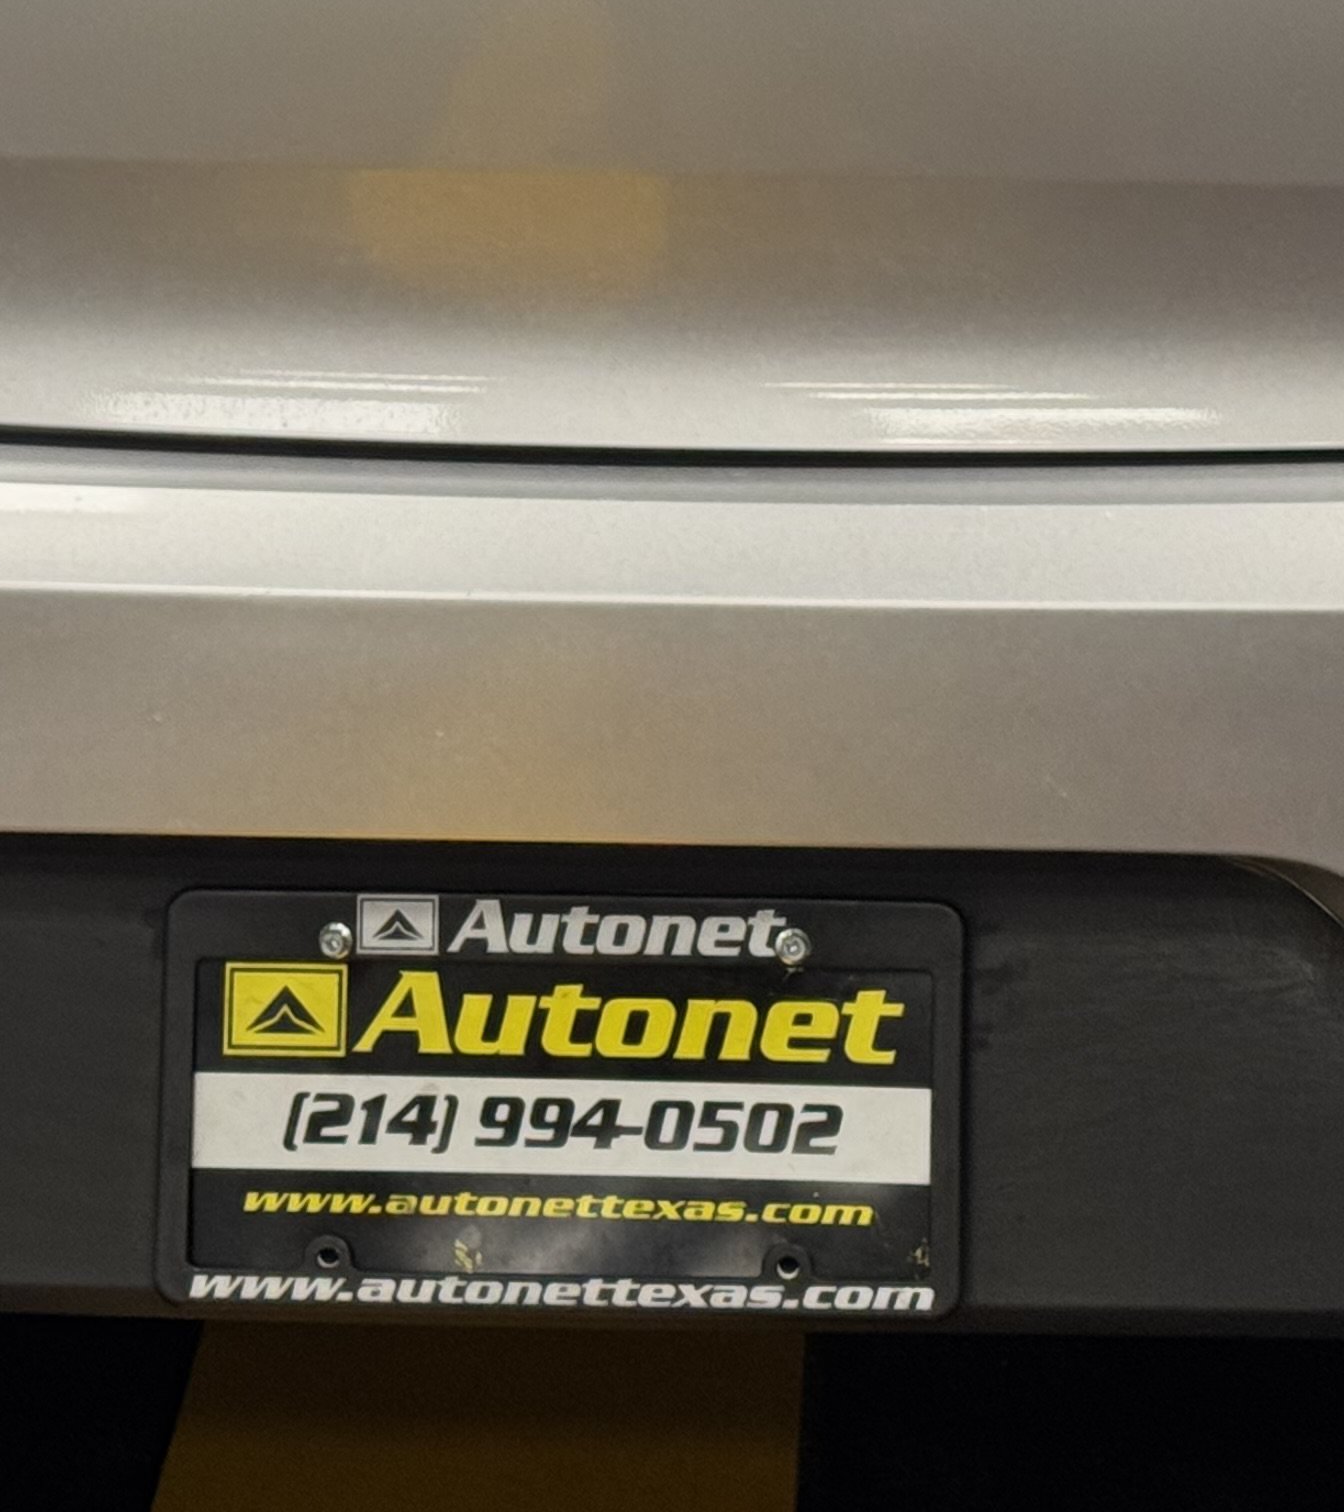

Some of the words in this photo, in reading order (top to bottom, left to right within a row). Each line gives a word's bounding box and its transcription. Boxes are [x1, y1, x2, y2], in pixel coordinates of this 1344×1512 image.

[447, 899, 787, 958] Autonet
[353, 970, 905, 1065] Autonet
[283, 1091, 458, 1155] (214)
[474, 1095, 843, 1155] 994-0502
[243, 1190, 874, 1226] www.autonettexas.com
[188, 1272, 935, 1312] www.autonettexas.com
